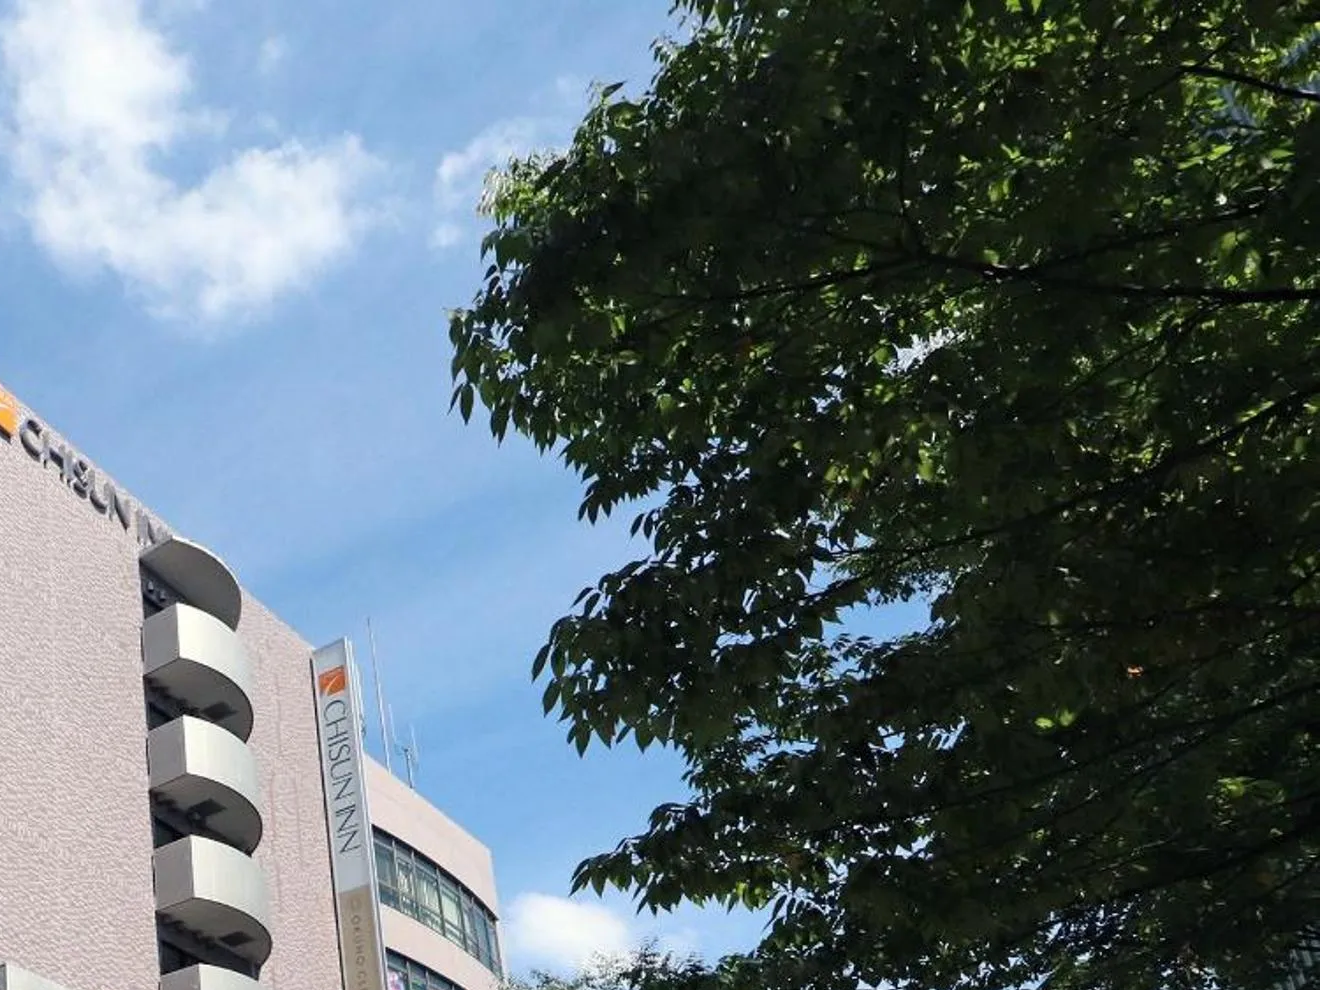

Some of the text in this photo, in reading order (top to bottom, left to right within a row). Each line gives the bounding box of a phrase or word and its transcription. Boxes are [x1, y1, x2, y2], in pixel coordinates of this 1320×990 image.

[19, 418, 130, 532] CHISUN
[323, 699, 362, 854] CHISUN INN
